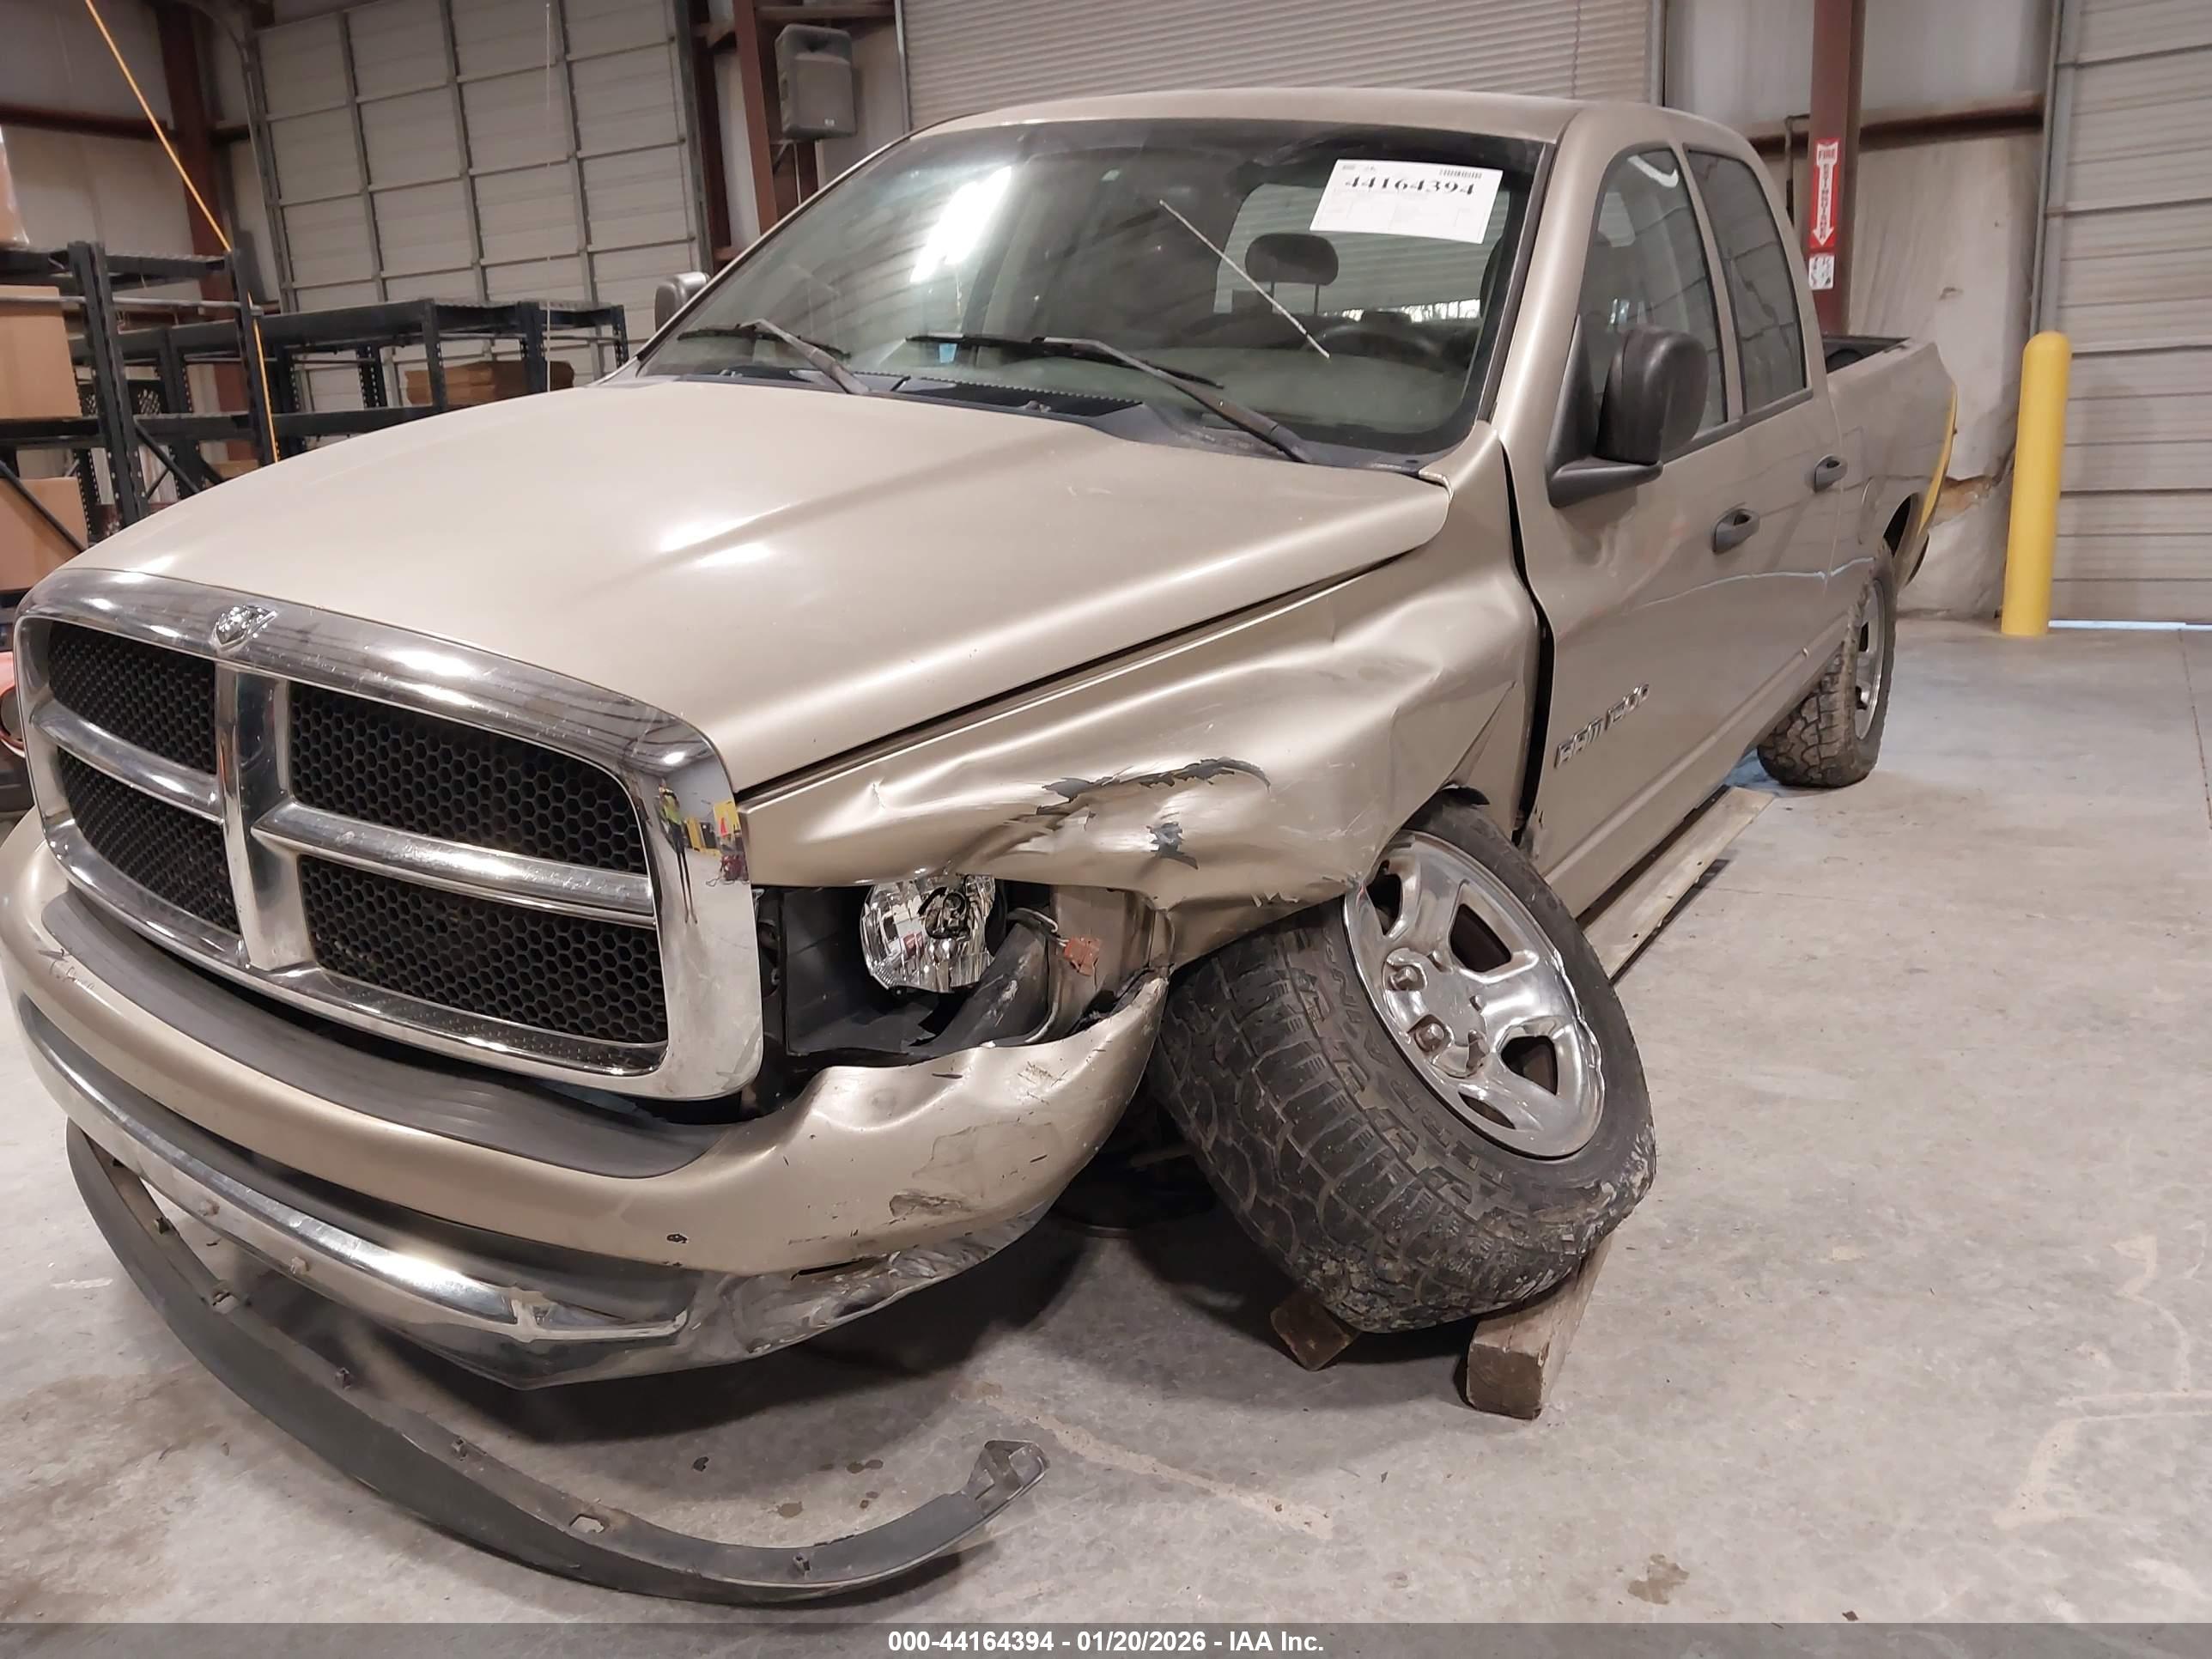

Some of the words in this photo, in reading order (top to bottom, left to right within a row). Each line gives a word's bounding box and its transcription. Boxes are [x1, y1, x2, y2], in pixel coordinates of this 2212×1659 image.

[1818, 149, 1836, 161] FIRE
[1344, 176, 1476, 197] 44164394
[1604, 683, 1650, 731] 1500
